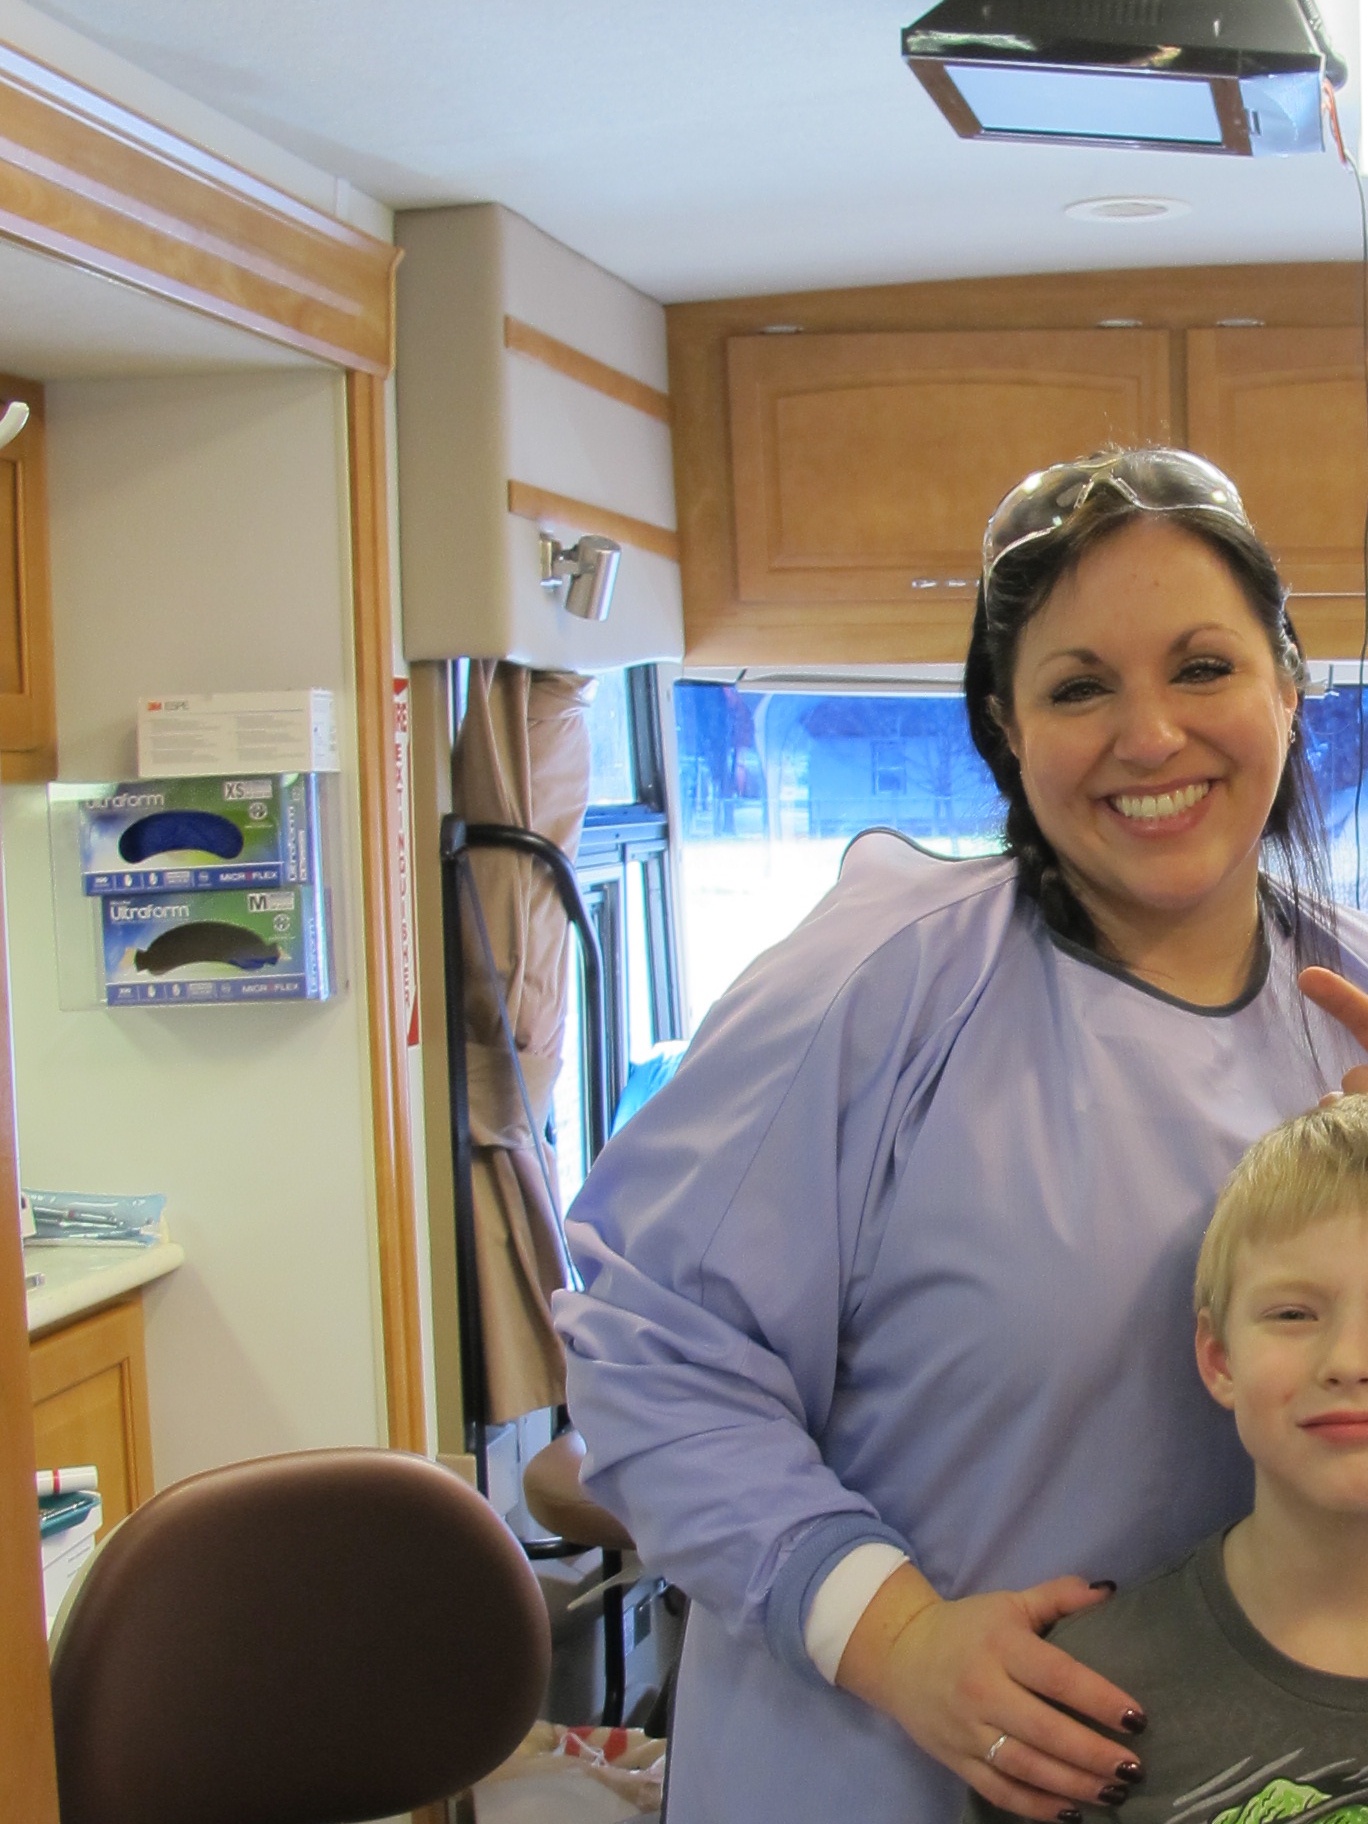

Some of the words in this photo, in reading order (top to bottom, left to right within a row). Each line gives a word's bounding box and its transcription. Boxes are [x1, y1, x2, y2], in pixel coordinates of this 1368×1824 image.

[225, 782, 244, 799] XS
[250, 895, 267, 910] M
[110, 904, 190, 920] Ultraform
